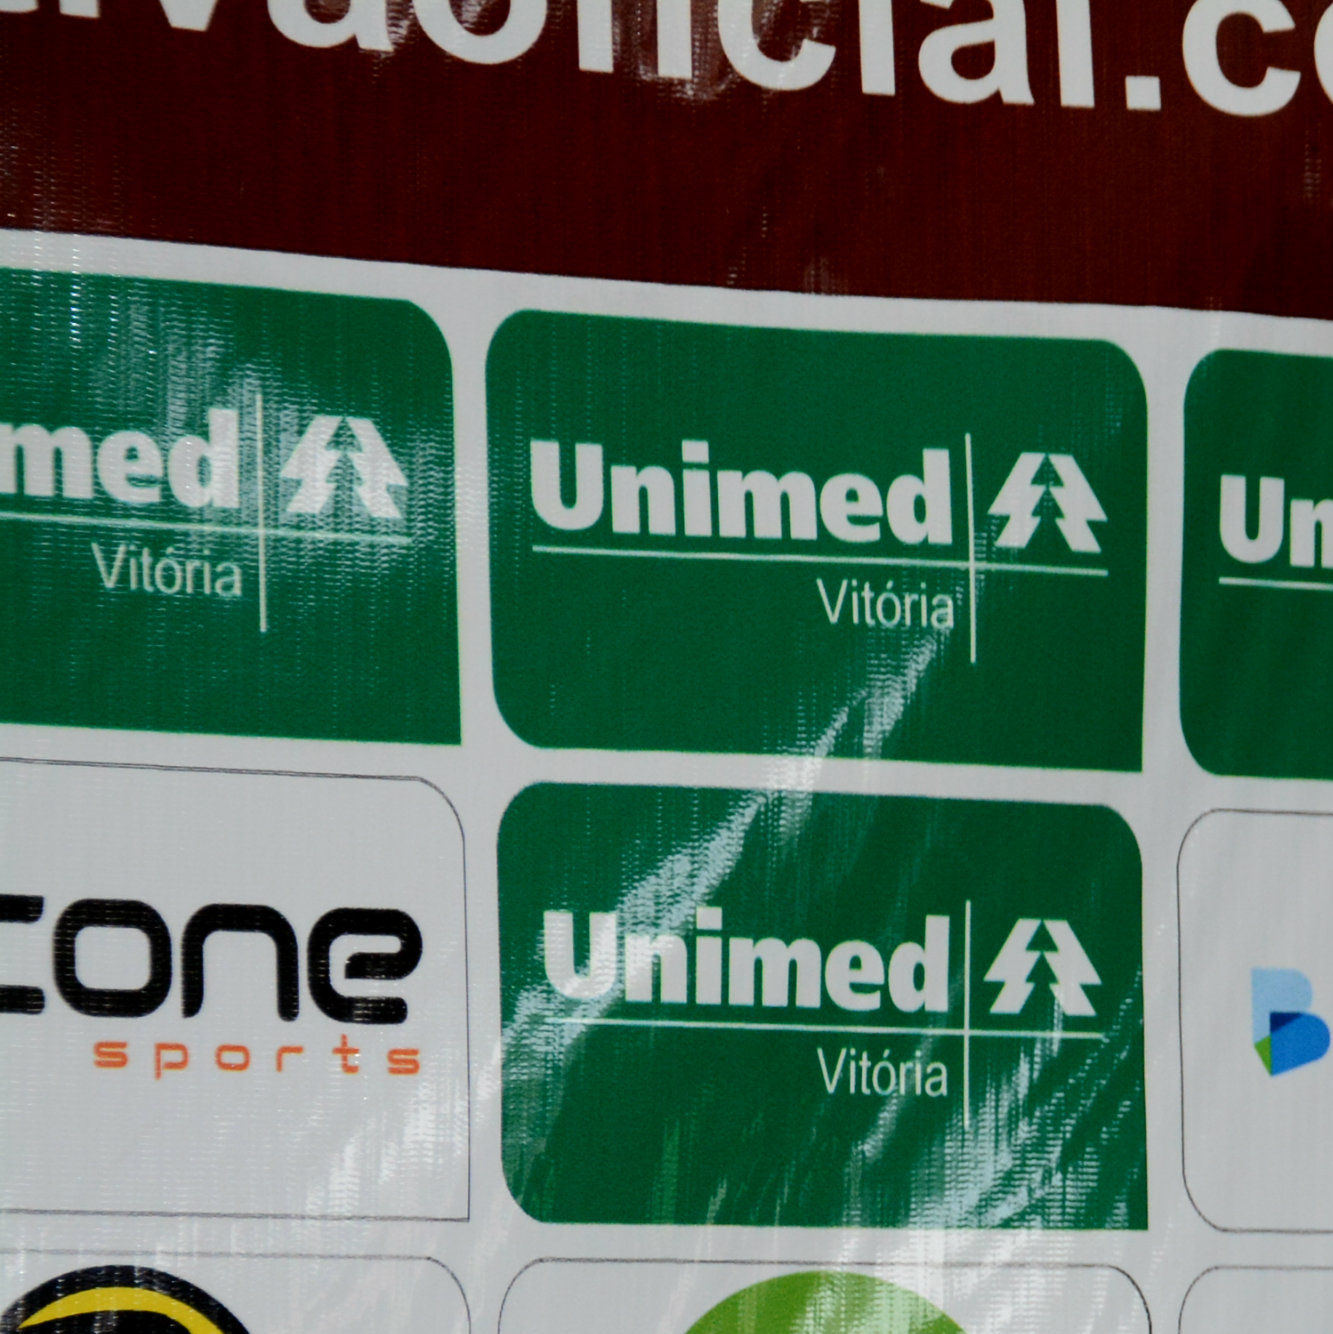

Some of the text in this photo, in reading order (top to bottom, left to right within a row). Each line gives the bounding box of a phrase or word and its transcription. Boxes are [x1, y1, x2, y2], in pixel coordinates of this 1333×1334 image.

[530, 440, 953, 545] Unimed
[92, 543, 242, 598] Vitória
[816, 577, 954, 629] Vitória
[543, 907, 951, 1014] Unimed
[93, 1034, 421, 1080] sports
[817, 1046, 949, 1098] Vitória
